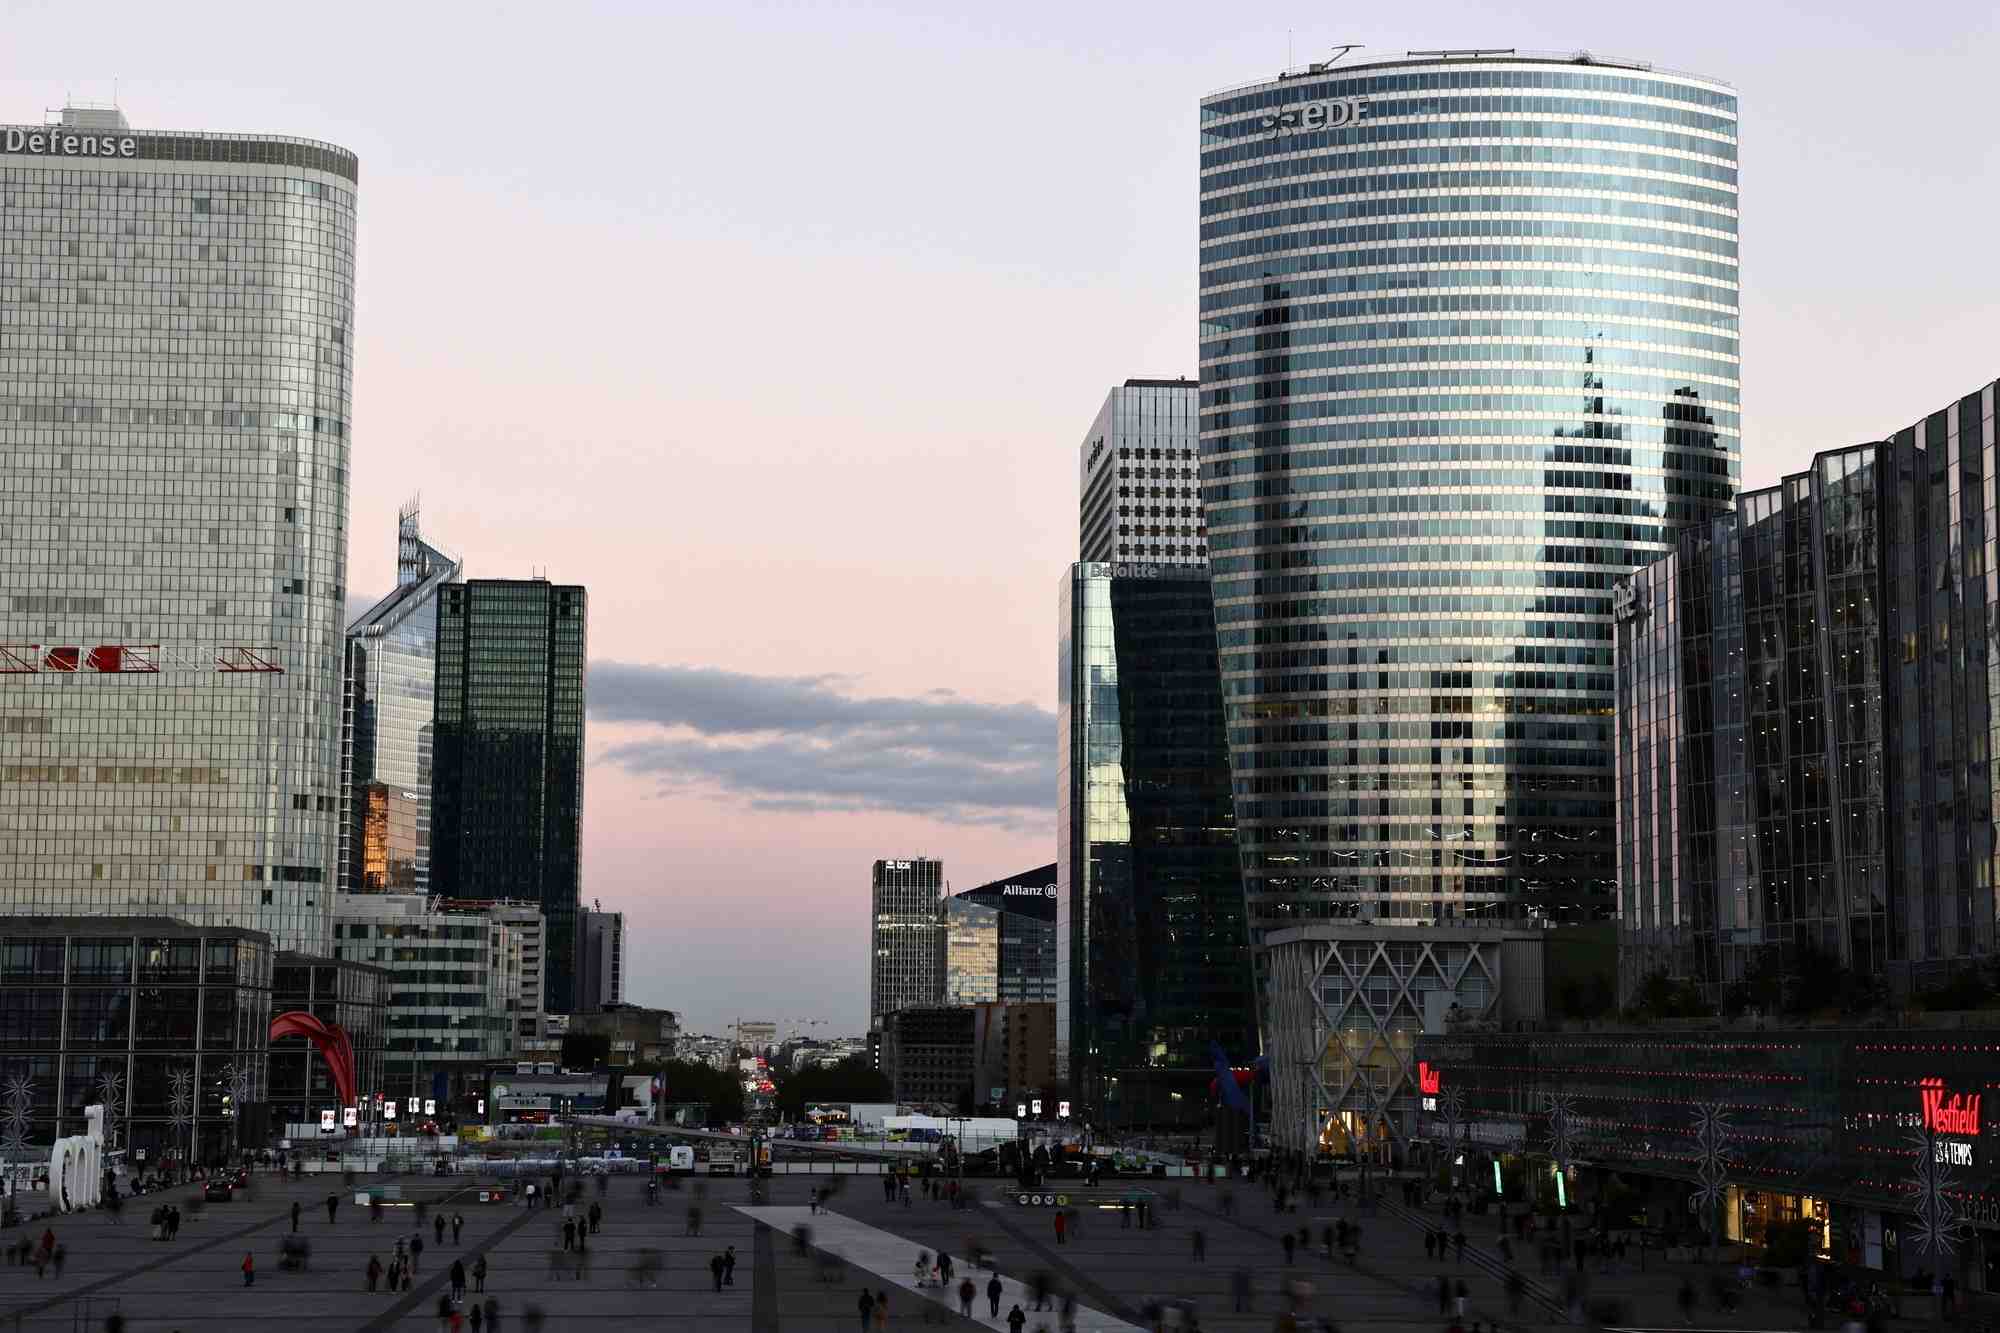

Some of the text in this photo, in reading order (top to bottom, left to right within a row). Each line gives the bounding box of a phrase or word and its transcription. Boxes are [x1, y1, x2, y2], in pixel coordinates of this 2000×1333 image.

[6, 129, 136, 157] Défense
[1090, 562, 1158, 578] Deloitte
[1003, 884, 1043, 896] Allianz
[1920, 1079, 1981, 1136] Westfield
[1950, 1142, 1973, 1167] TEMPS
